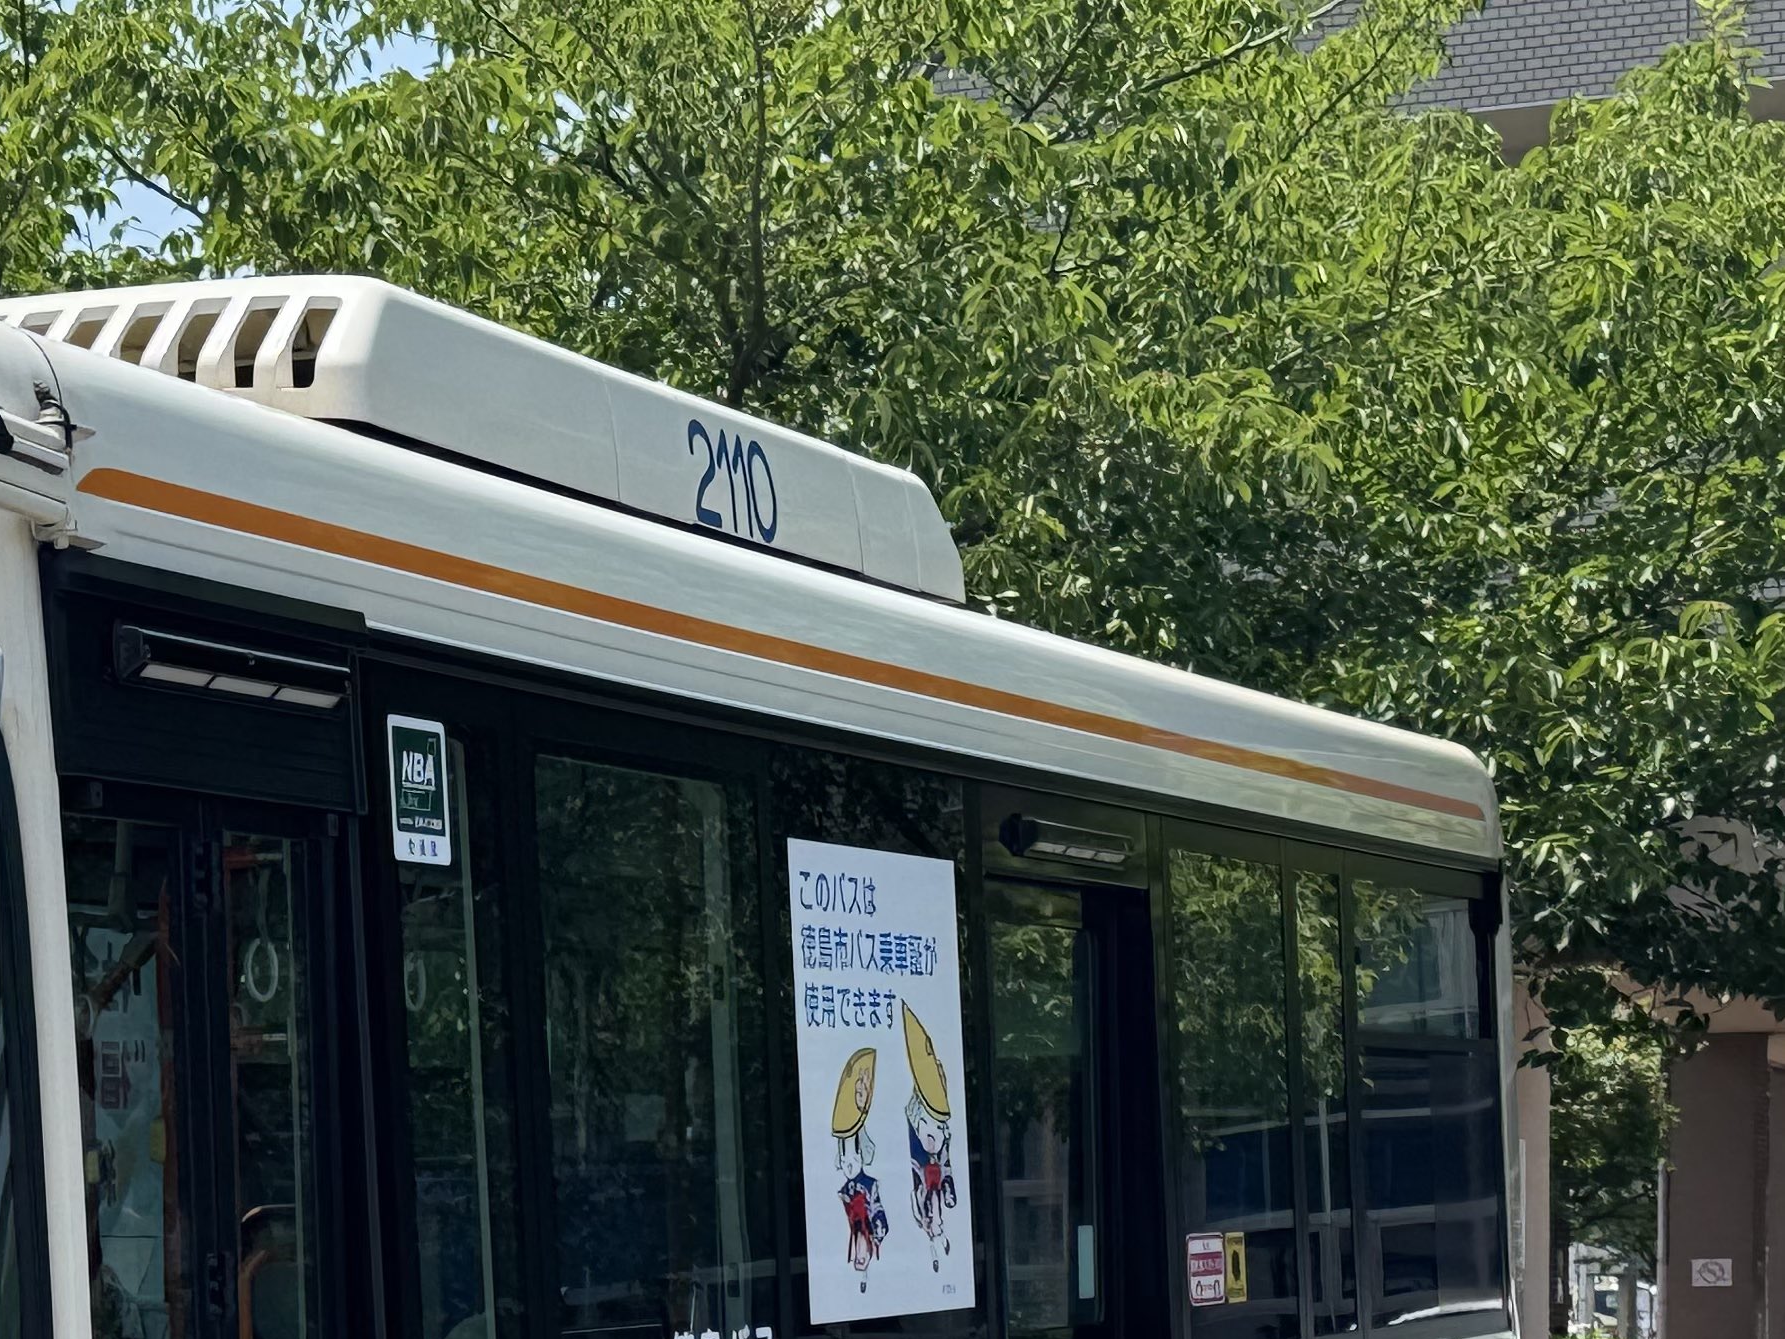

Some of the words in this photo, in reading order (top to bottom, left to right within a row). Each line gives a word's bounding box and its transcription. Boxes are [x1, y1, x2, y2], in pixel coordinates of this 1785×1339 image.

[687, 418, 778, 544] 2110
[401, 749, 436, 788] NBA
[799, 870, 877, 917] このバスは
[804, 981, 897, 1030] 使用できます
